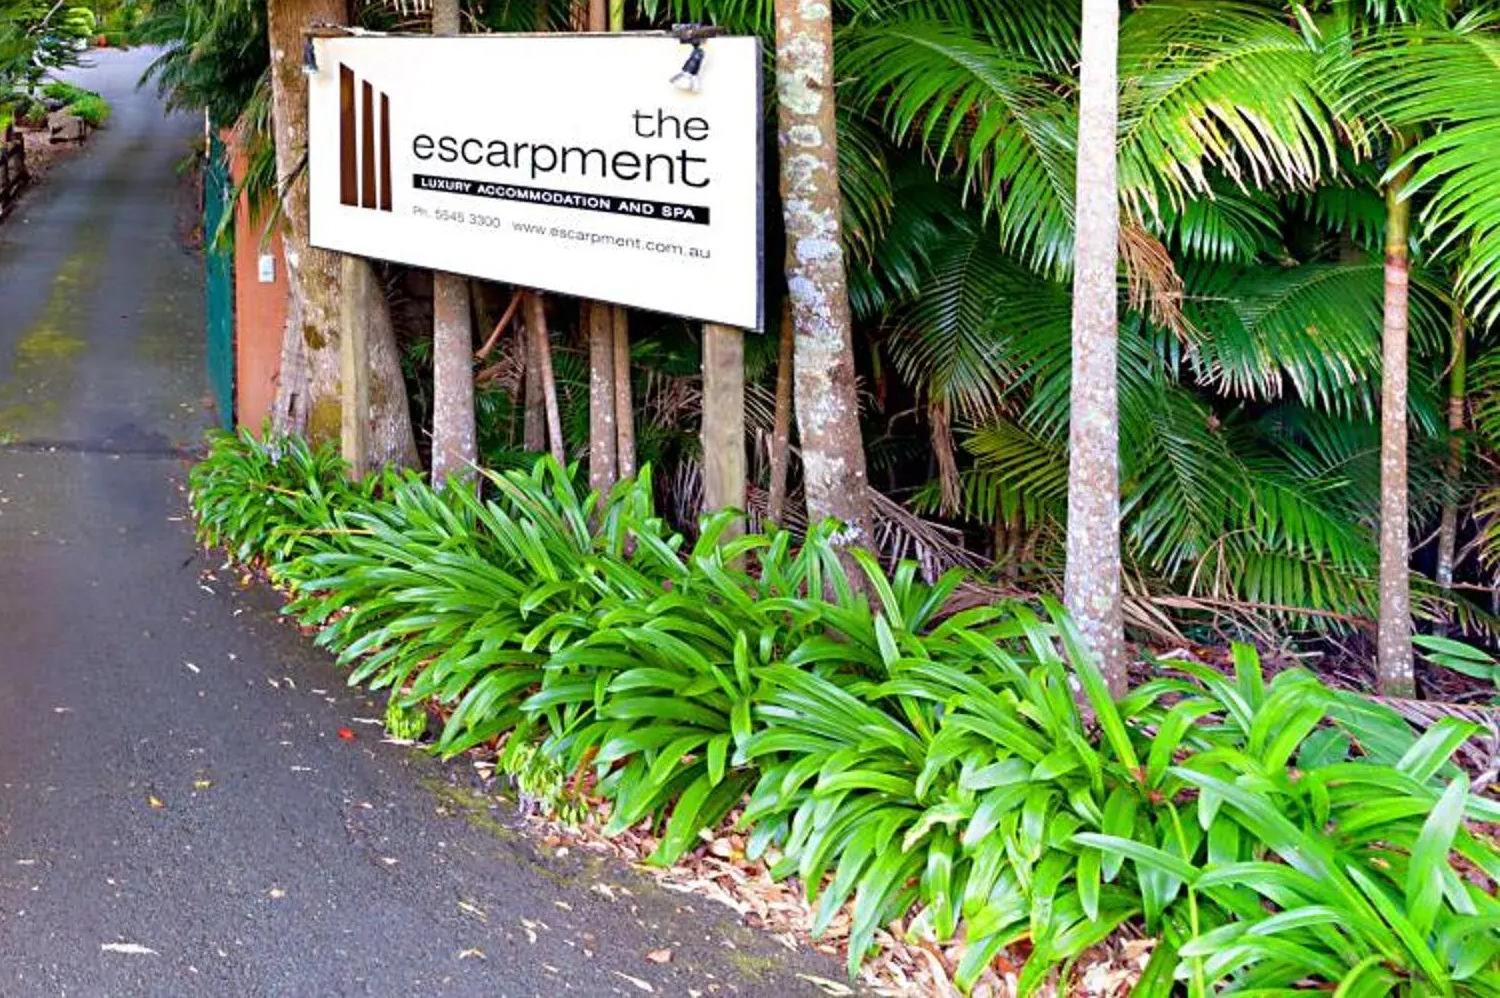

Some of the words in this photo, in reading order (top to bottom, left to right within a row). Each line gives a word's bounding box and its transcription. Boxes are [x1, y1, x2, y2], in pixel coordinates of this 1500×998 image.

[632, 108, 710, 141] the
[412, 133, 711, 188] escarpment
[421, 177, 472, 193] LUXURY
[477, 184, 612, 210] ACCOMMODATION
[618, 201, 655, 216] AND
[661, 205, 696, 221] SPA
[435, 207, 465, 224] 5545
[469, 212, 501, 229] 3300
[511, 220, 712, 260] www.escarpment.com.au
